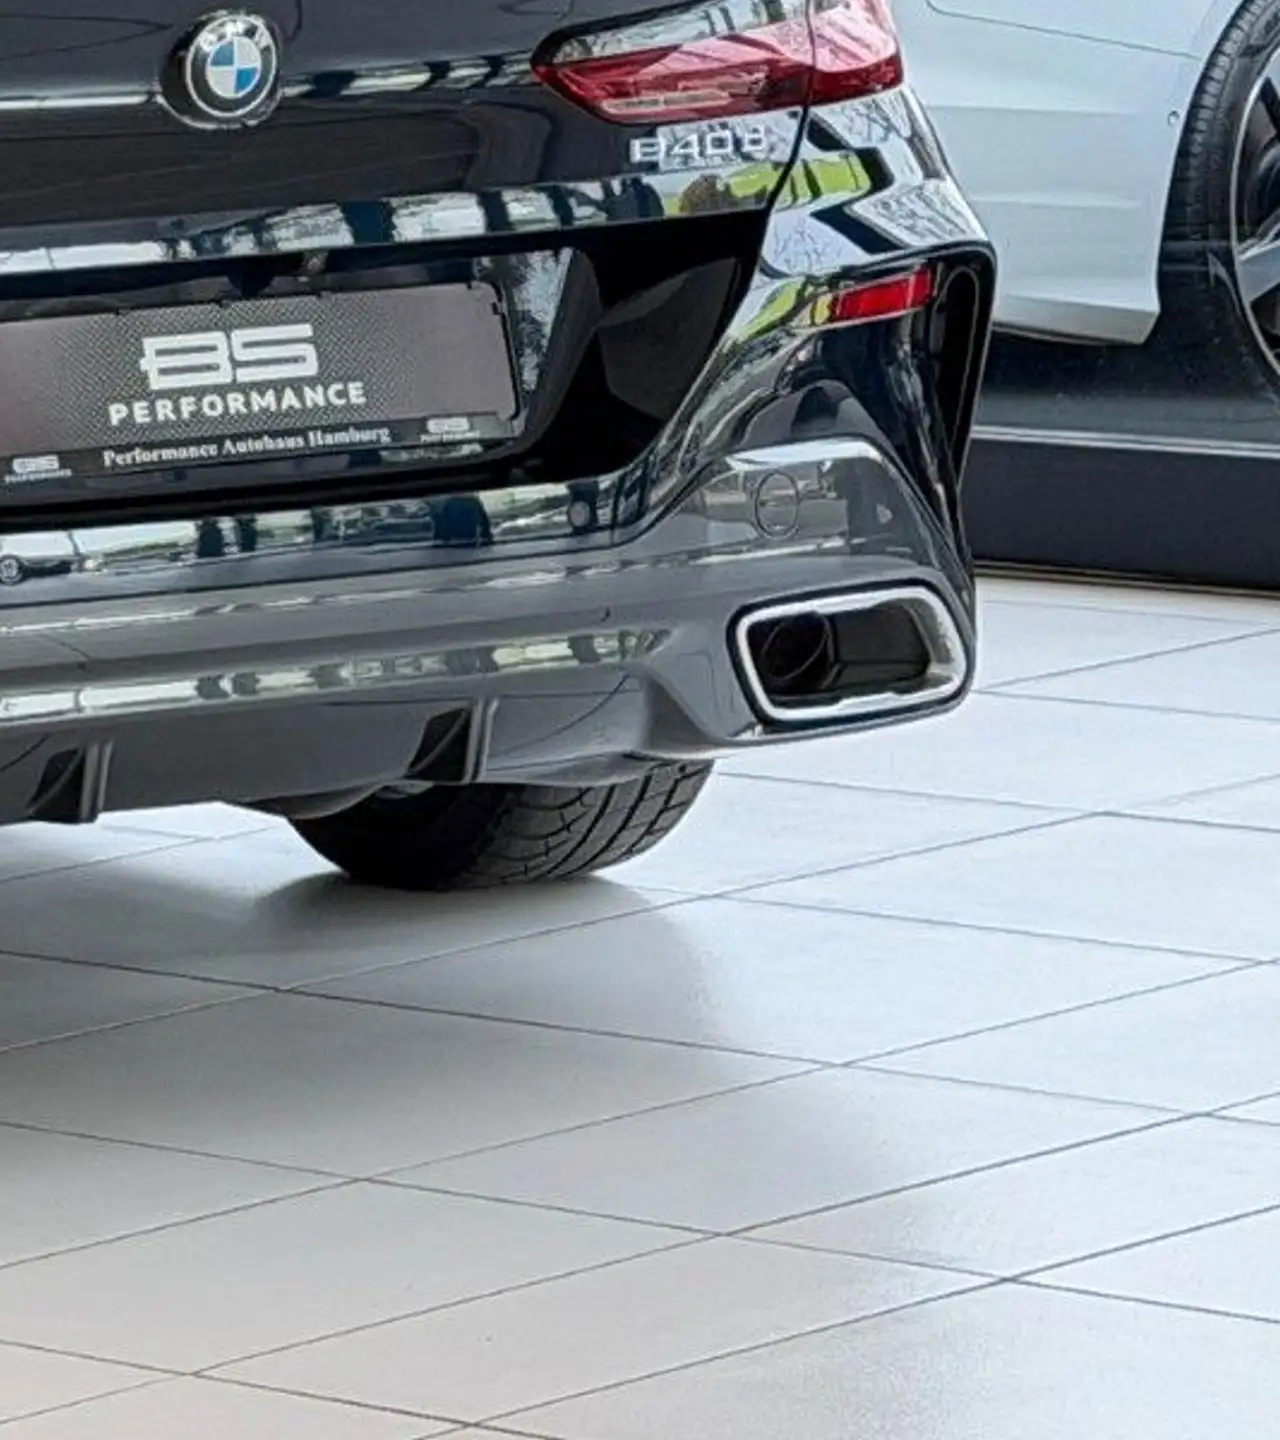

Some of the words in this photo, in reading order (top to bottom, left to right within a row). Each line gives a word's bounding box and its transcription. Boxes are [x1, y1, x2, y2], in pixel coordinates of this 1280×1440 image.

[108, 380, 367, 427] PERFORMANCE
[102, 442, 219, 468] Performance
[221, 433, 305, 456] Autohaus
[307, 425, 391, 448] Hamburg
